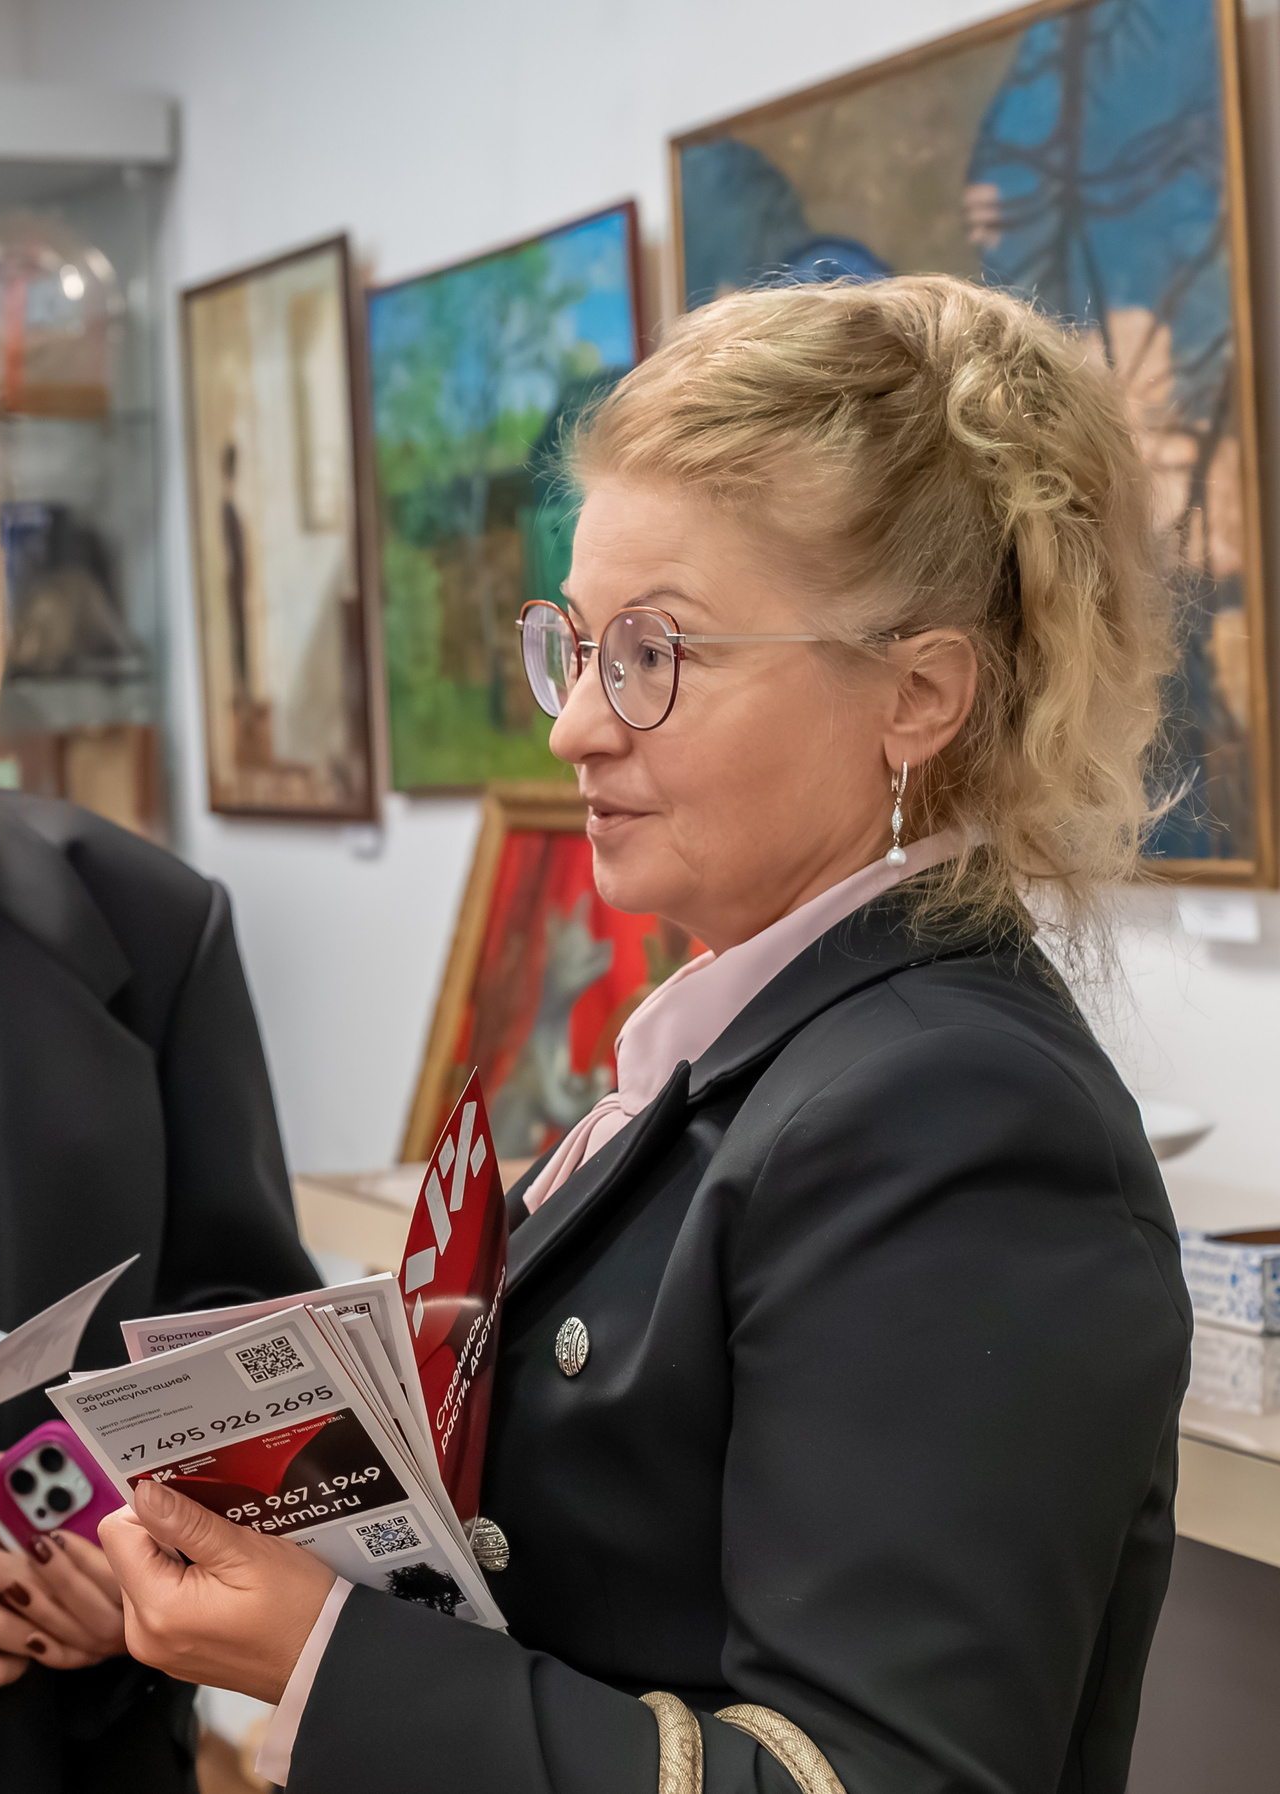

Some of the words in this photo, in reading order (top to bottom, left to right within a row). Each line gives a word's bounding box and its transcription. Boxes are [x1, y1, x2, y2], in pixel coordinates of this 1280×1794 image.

[147, 1330, 213, 1343] Обратись
[150, 1345, 165, 1353] за
[436, 1314, 484, 1431] Стремись,
[76, 1383, 138, 1405] Обратись
[81, 1405, 98, 1413] за
[100, 1373, 192, 1408] консультацией
[121, 1444, 146, 1462] +7
[157, 1427, 206, 1451] 495
[210, 1410, 261, 1434] 926
[265, 1385, 334, 1418] 2695
[440, 1380, 470, 1456] расти,
[226, 1502, 261, 1522] 95
[265, 1486, 308, 1510] 967
[318, 1466, 381, 1496] 1949
[296, 1537, 316, 1547] язи
